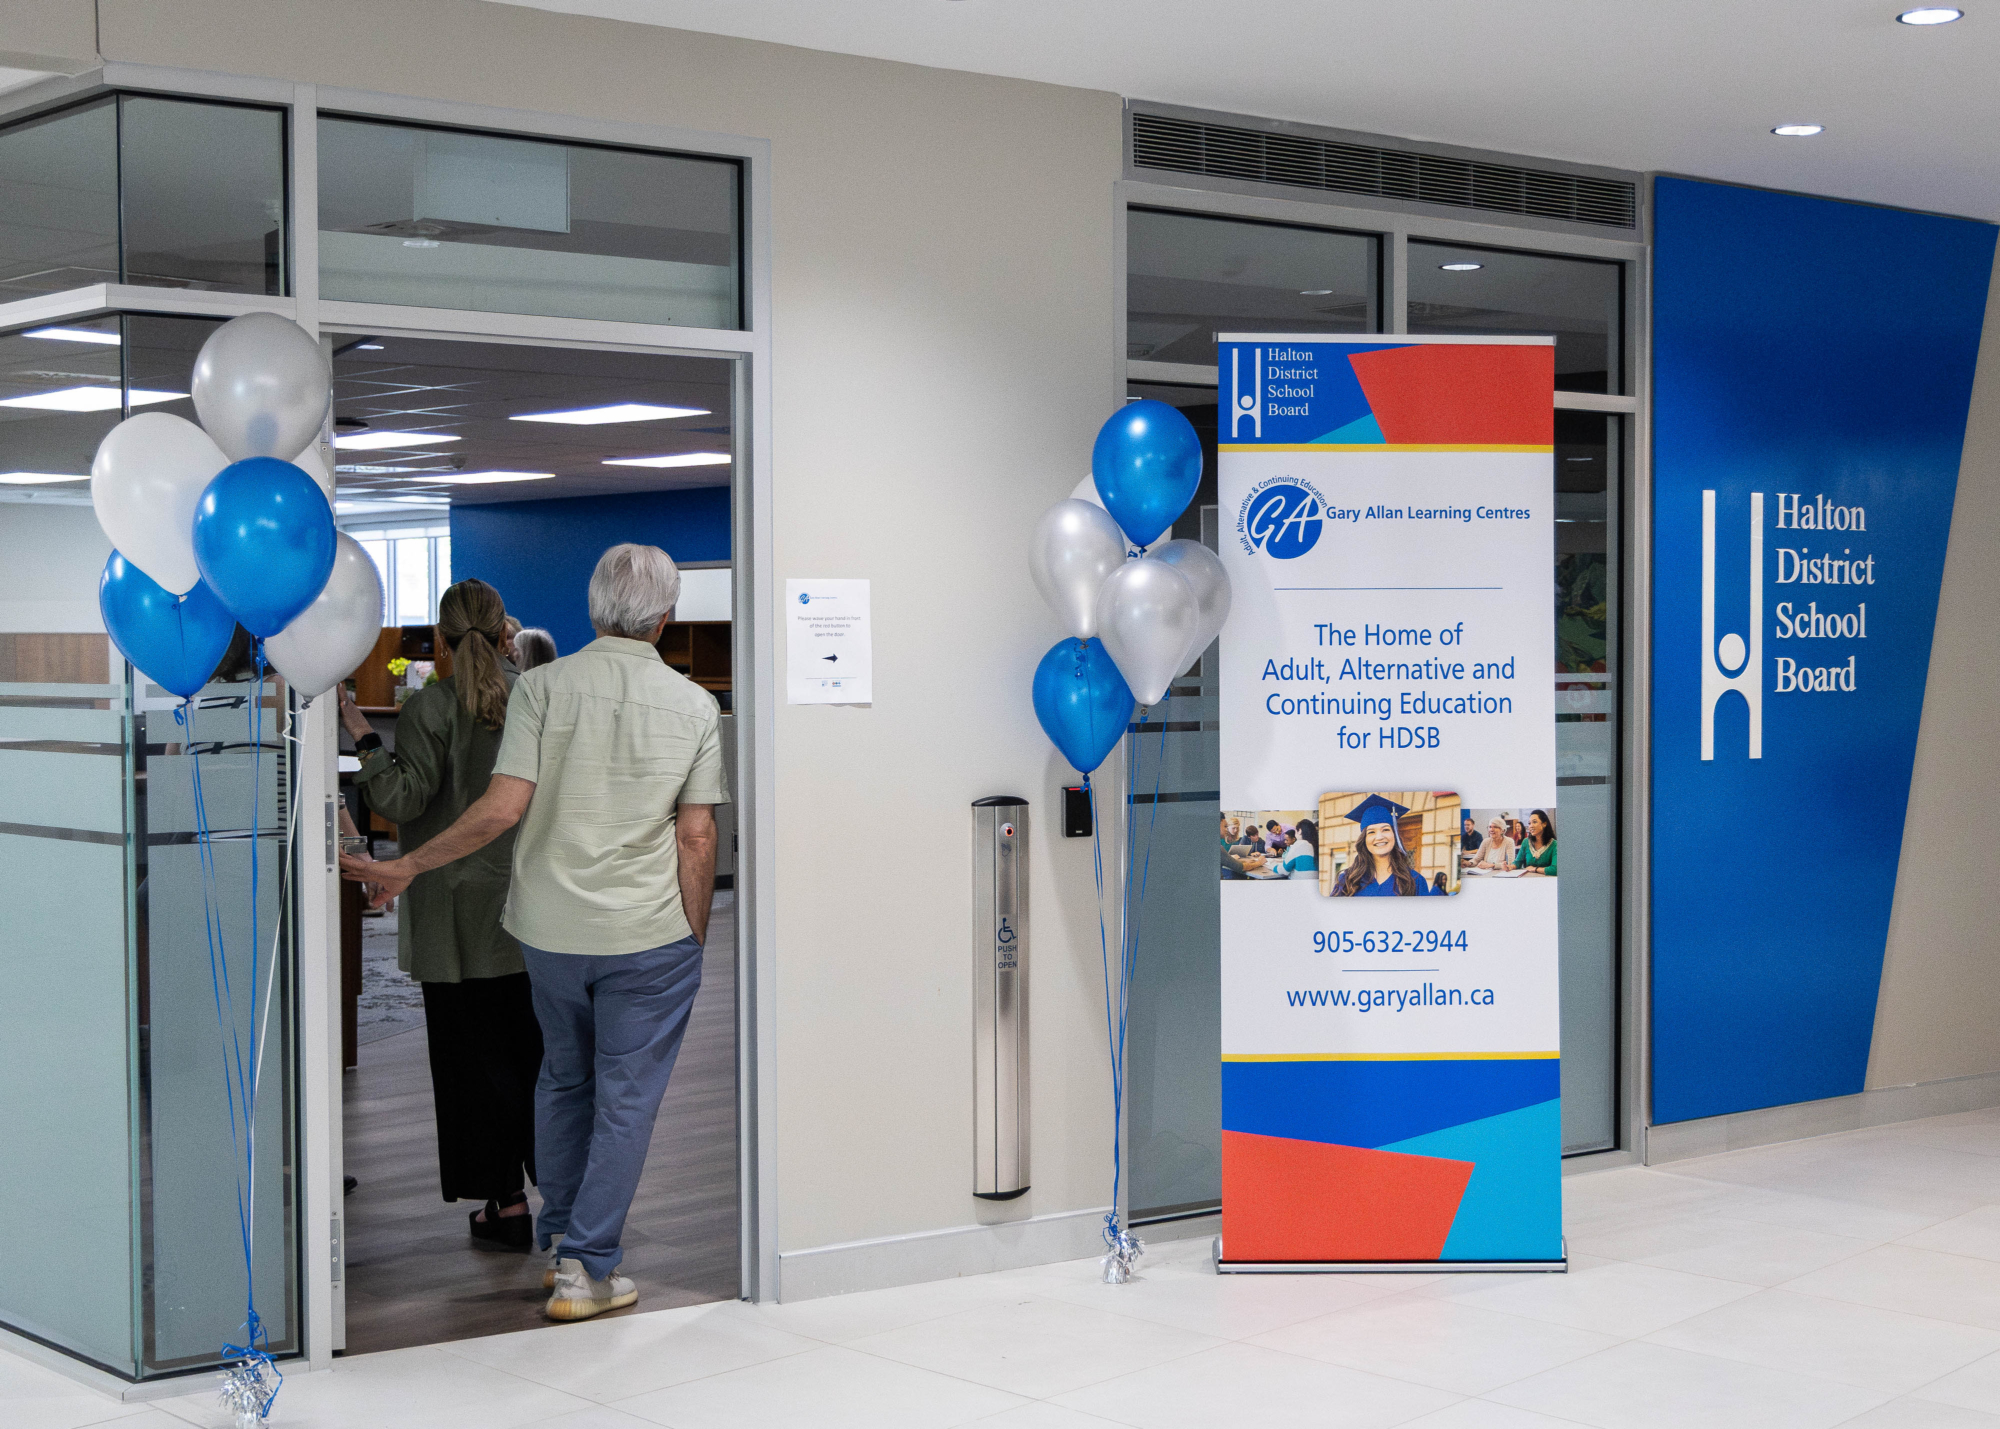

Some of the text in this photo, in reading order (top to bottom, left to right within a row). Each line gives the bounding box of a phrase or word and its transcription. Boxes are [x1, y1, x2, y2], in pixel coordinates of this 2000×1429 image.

[1268, 347, 1314, 361] Halton
[1268, 366, 1319, 379] District
[1268, 384, 1314, 398] School
[1268, 402, 1309, 416] Board
[1236, 475, 1328, 556] Adult, Alternative & Continuing Education
[1326, 505, 1531, 523] Gary Allan Learning Centres
[1775, 493, 1867, 531] Halton
[1775, 547, 1875, 585] District
[1776, 601, 1867, 639] School
[1314, 622, 1463, 646] The Home of
[1262, 656, 1515, 684] Adult, Alternative and
[1774, 656, 1857, 693] Board
[1266, 691, 1512, 721] Continuing Education
[1337, 725, 1440, 749] for HDSB
[1313, 930, 1468, 953] 905-632-2944
[998, 961, 1016, 969] OPEN
[1286, 982, 1495, 1012] www.garyallan.ca
